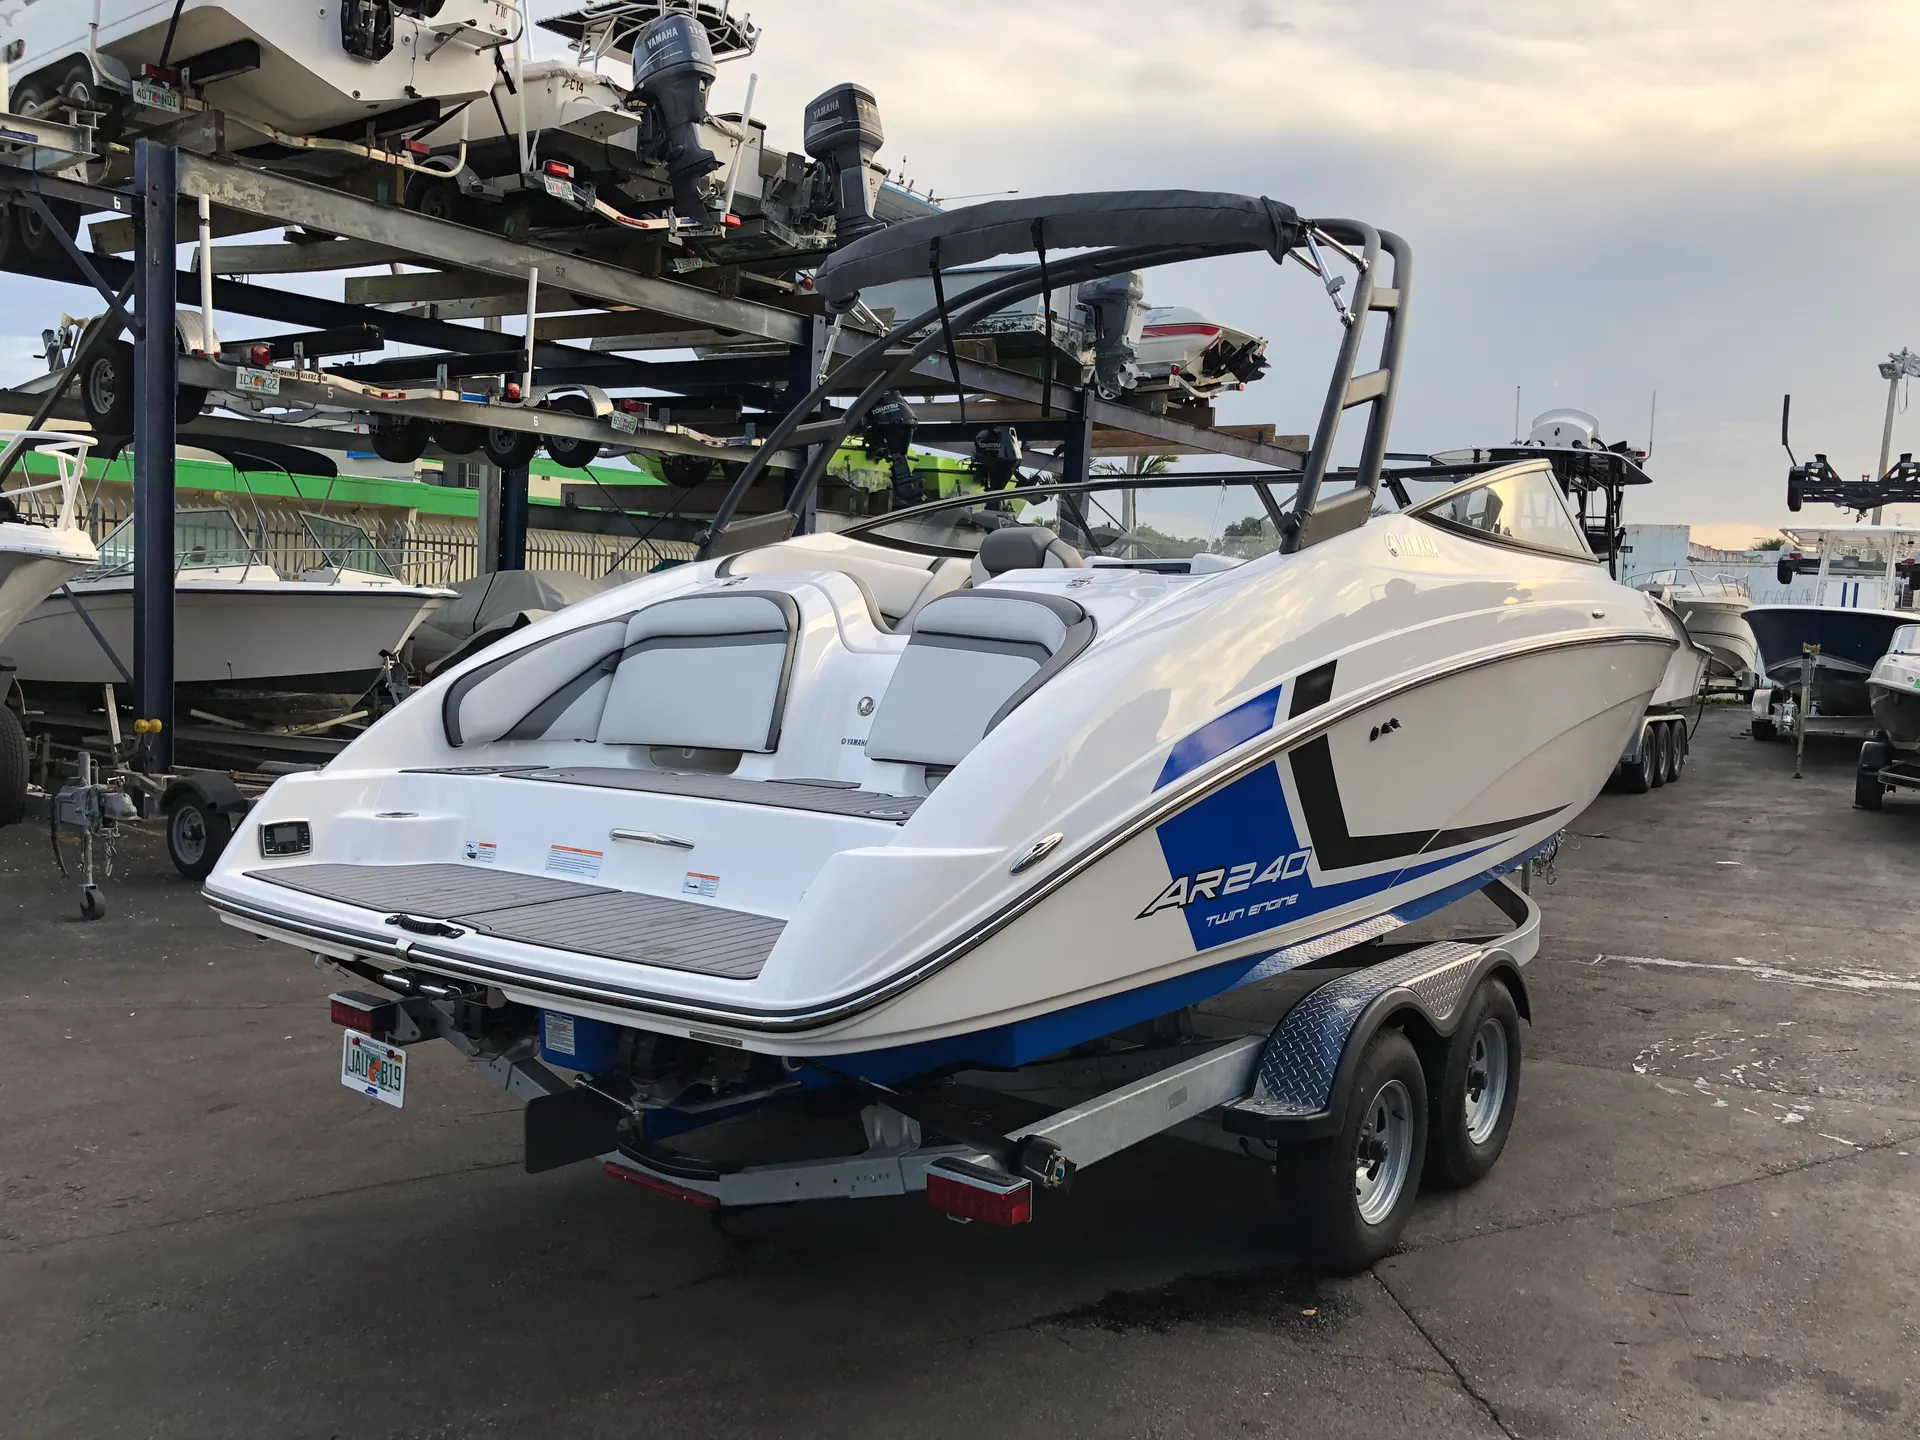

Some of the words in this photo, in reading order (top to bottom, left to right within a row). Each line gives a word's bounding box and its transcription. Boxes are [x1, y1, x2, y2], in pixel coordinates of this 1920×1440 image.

[646, 26, 679, 49] YAMAHA
[136, 87, 152, 101] 407
[812, 99, 840, 120] YAMAHA
[113, 195, 121, 210] 6
[239, 372, 254, 386] ICX
[262, 377, 278, 390] K22
[327, 386, 334, 399] 5
[871, 402, 899, 415] TOHATSU
[1395, 534, 1441, 558] YAMAHA
[1134, 846, 1313, 920] AR240
[1206, 908, 1245, 927] TWIN
[1248, 893, 1299, 916] ENGINE
[347, 1049, 368, 1078] JAU
[381, 1061, 402, 1091] B19
